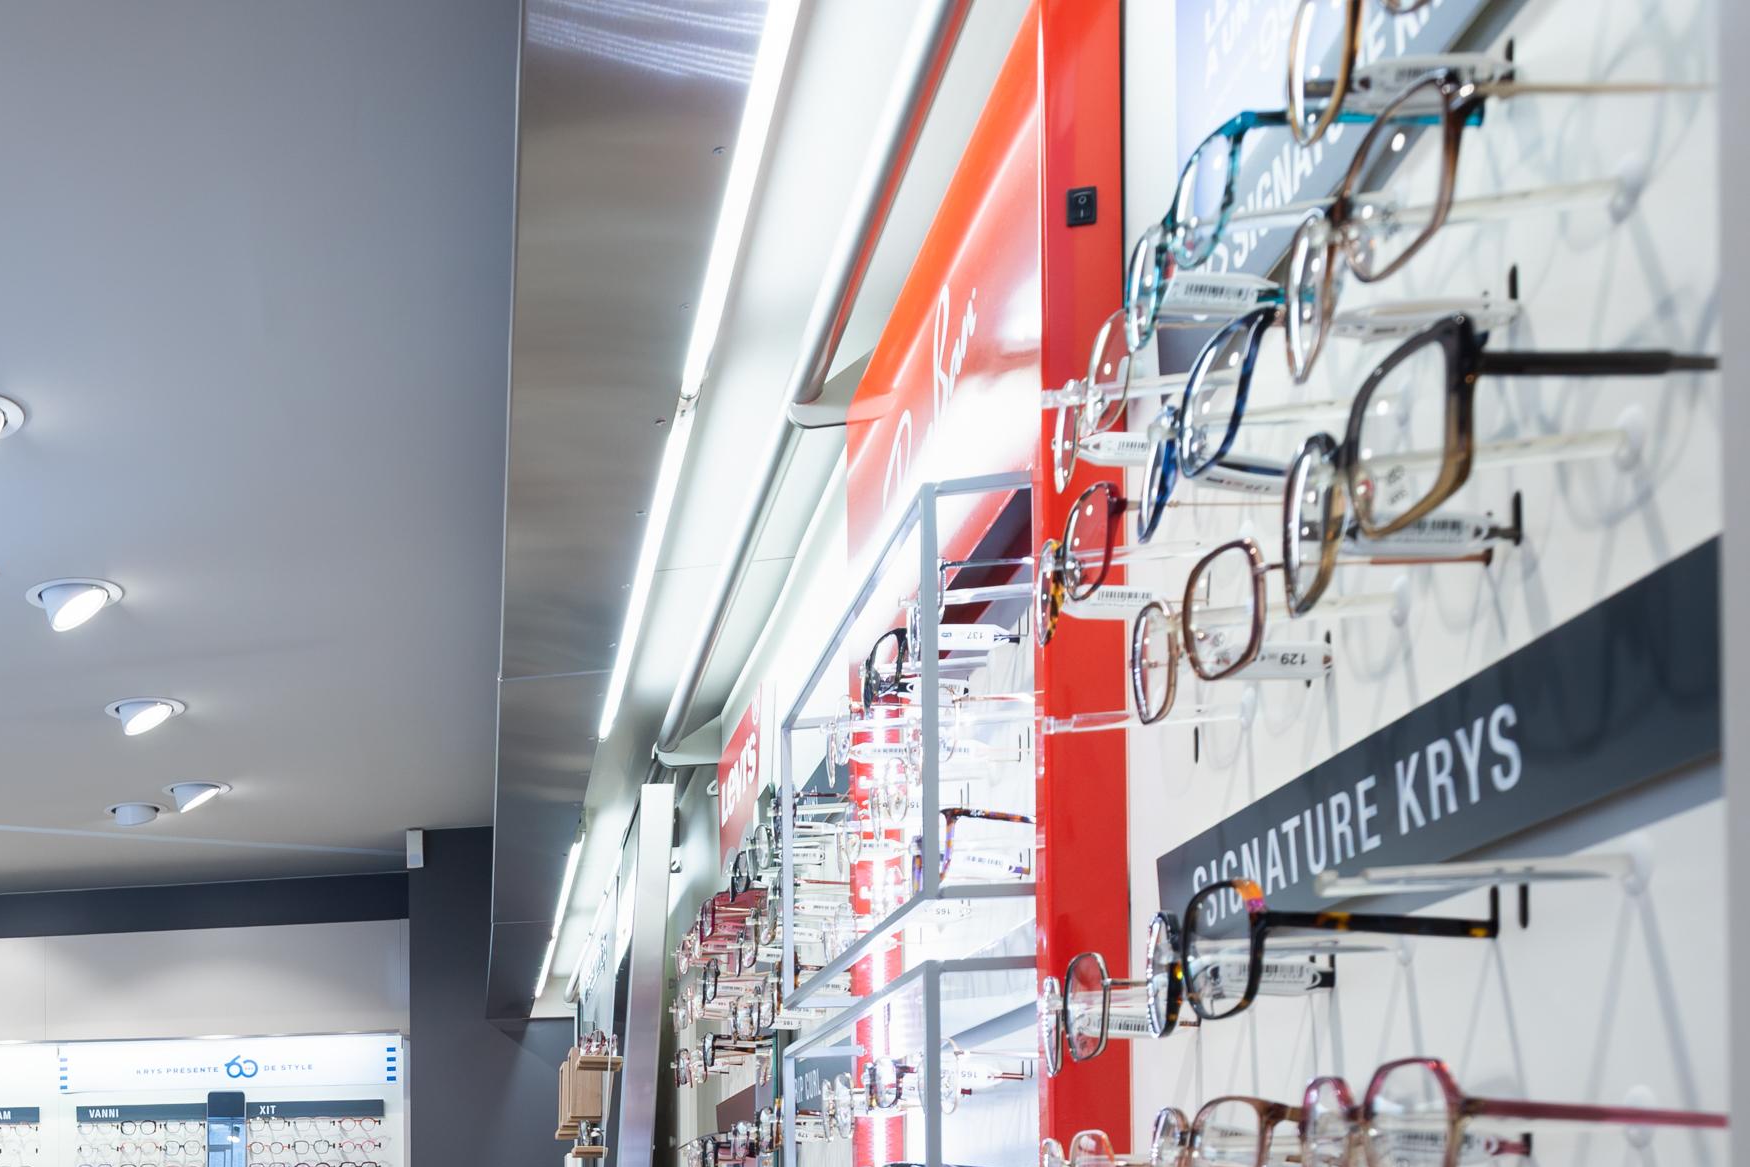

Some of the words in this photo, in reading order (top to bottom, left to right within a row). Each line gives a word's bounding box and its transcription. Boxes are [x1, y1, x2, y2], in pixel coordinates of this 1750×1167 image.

[1395, 703, 1523, 835] KRYS
[263, 1064, 277, 1072] DE
[280, 1063, 314, 1072] STYLE
[804, 1066, 821, 1101] CURL
[88, 1109, 119, 1118] VANNI
[259, 1105, 277, 1115] XIT
